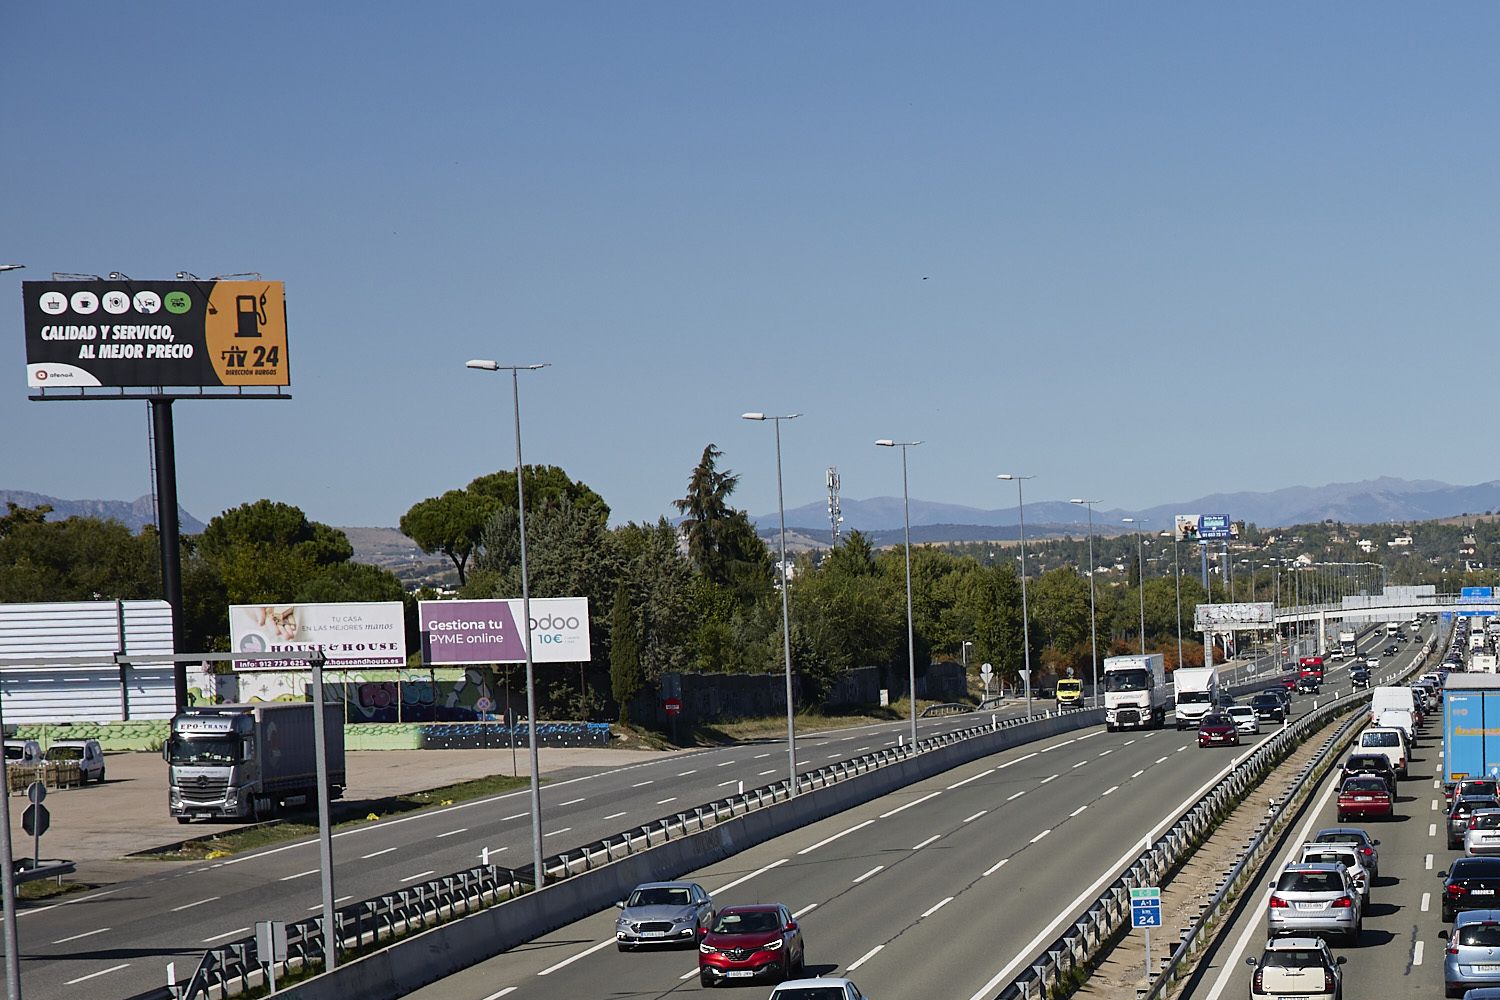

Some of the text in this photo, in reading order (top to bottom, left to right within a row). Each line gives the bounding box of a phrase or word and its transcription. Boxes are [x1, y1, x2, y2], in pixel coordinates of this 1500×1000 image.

[41, 325, 175, 343] CALIDAD Y SERVICIO,
[79, 343, 194, 359] AL MEJOR PRECIO
[252, 345, 279, 368] 24
[364, 622, 394, 630] manos
[428, 618, 503, 632] Gestiona tu
[529, 613, 580, 631] odoo
[429, 632, 504, 645] PYME online
[180, 722, 229, 730] EPO-TRANS
[1139, 915, 1155, 925] 24
